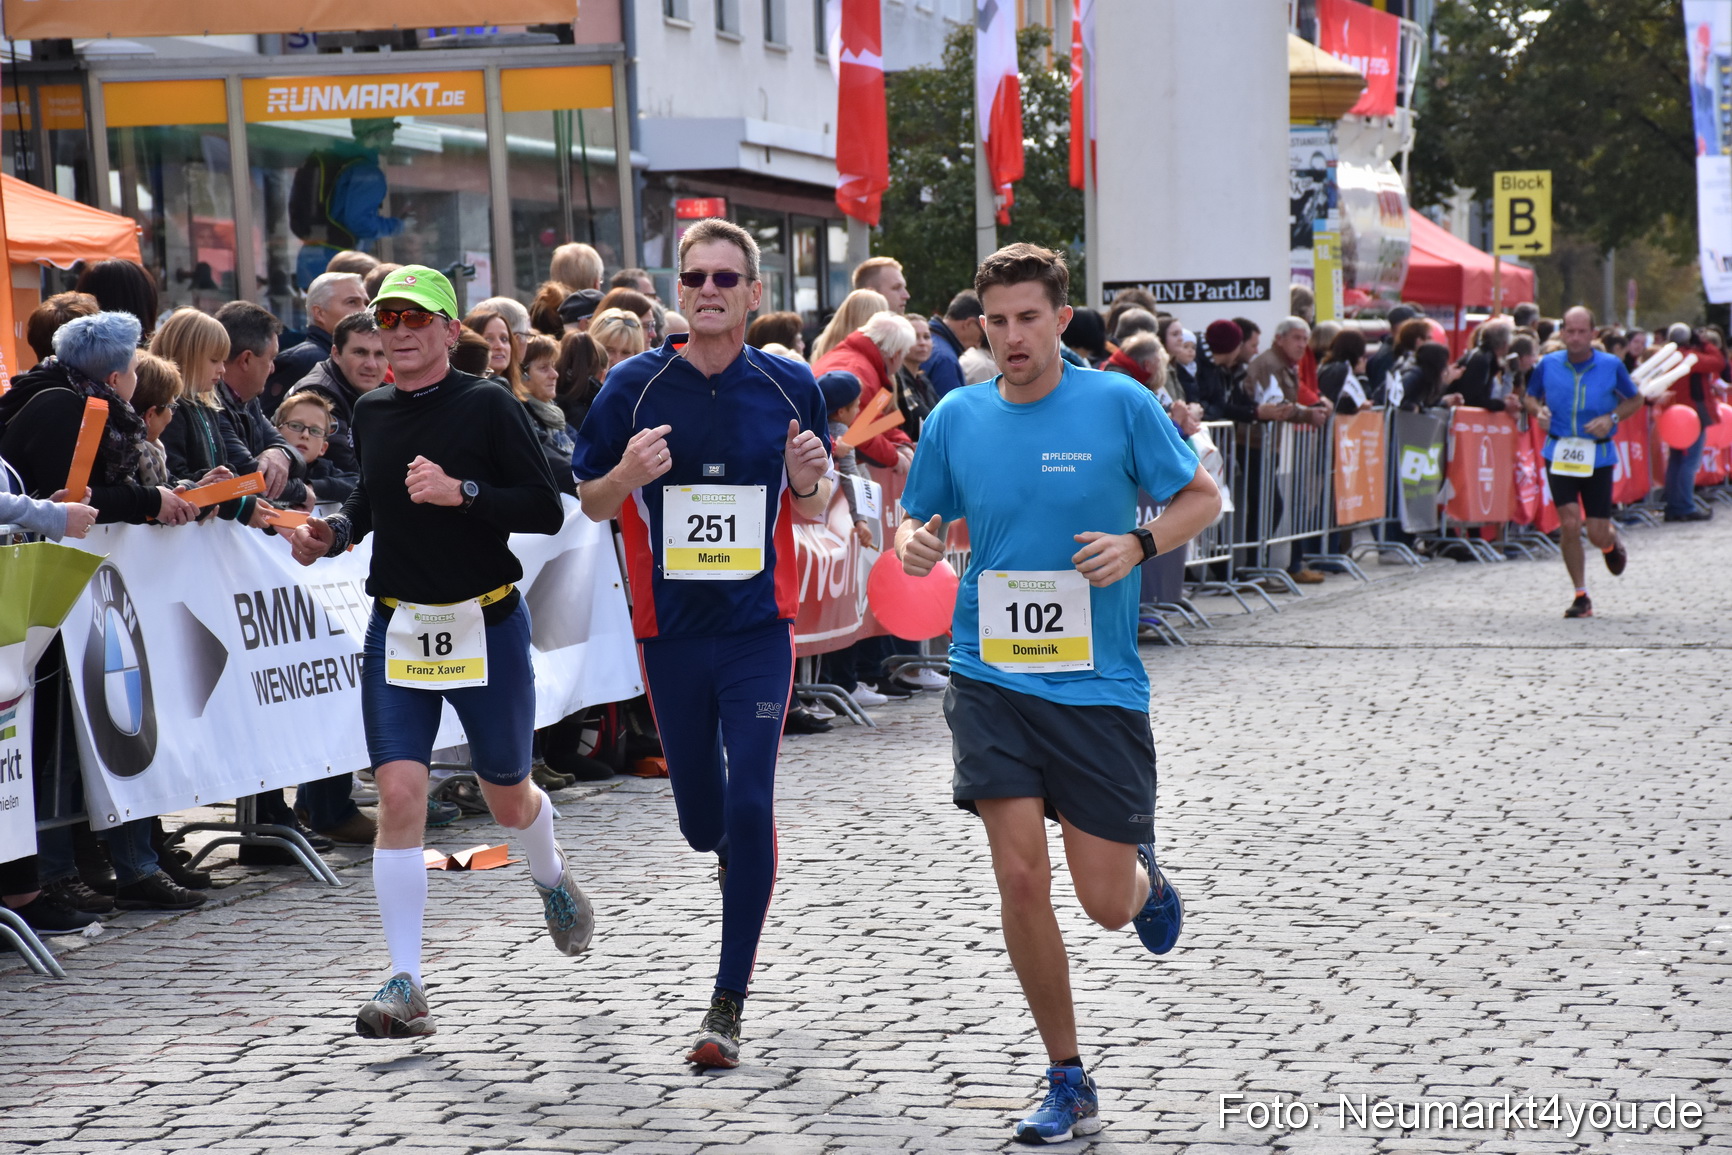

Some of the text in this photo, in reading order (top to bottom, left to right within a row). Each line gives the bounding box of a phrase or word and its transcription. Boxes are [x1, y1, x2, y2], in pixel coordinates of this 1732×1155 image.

[266, 82, 466, 113] RUNMARKT.DE
[1501, 175, 1545, 191] Block
[1509, 197, 1537, 237] B
[1050, 452, 1093, 461] PFLEIDERER
[1562, 449, 1585, 462] 246
[1041, 464, 1076, 473] Dominik
[702, 494, 736, 502] BOCK
[687, 514, 736, 542] 251
[698, 553, 731, 563] Martin
[1019, 581, 1057, 590] BOCK
[233, 584, 316, 651] BMW
[1005, 602, 1064, 633] 102
[417, 632, 453, 657] 18
[1012, 644, 1059, 655] Dominik
[406, 665, 466, 675] Franz Xaver
[250, 657, 343, 707] WENIGER
